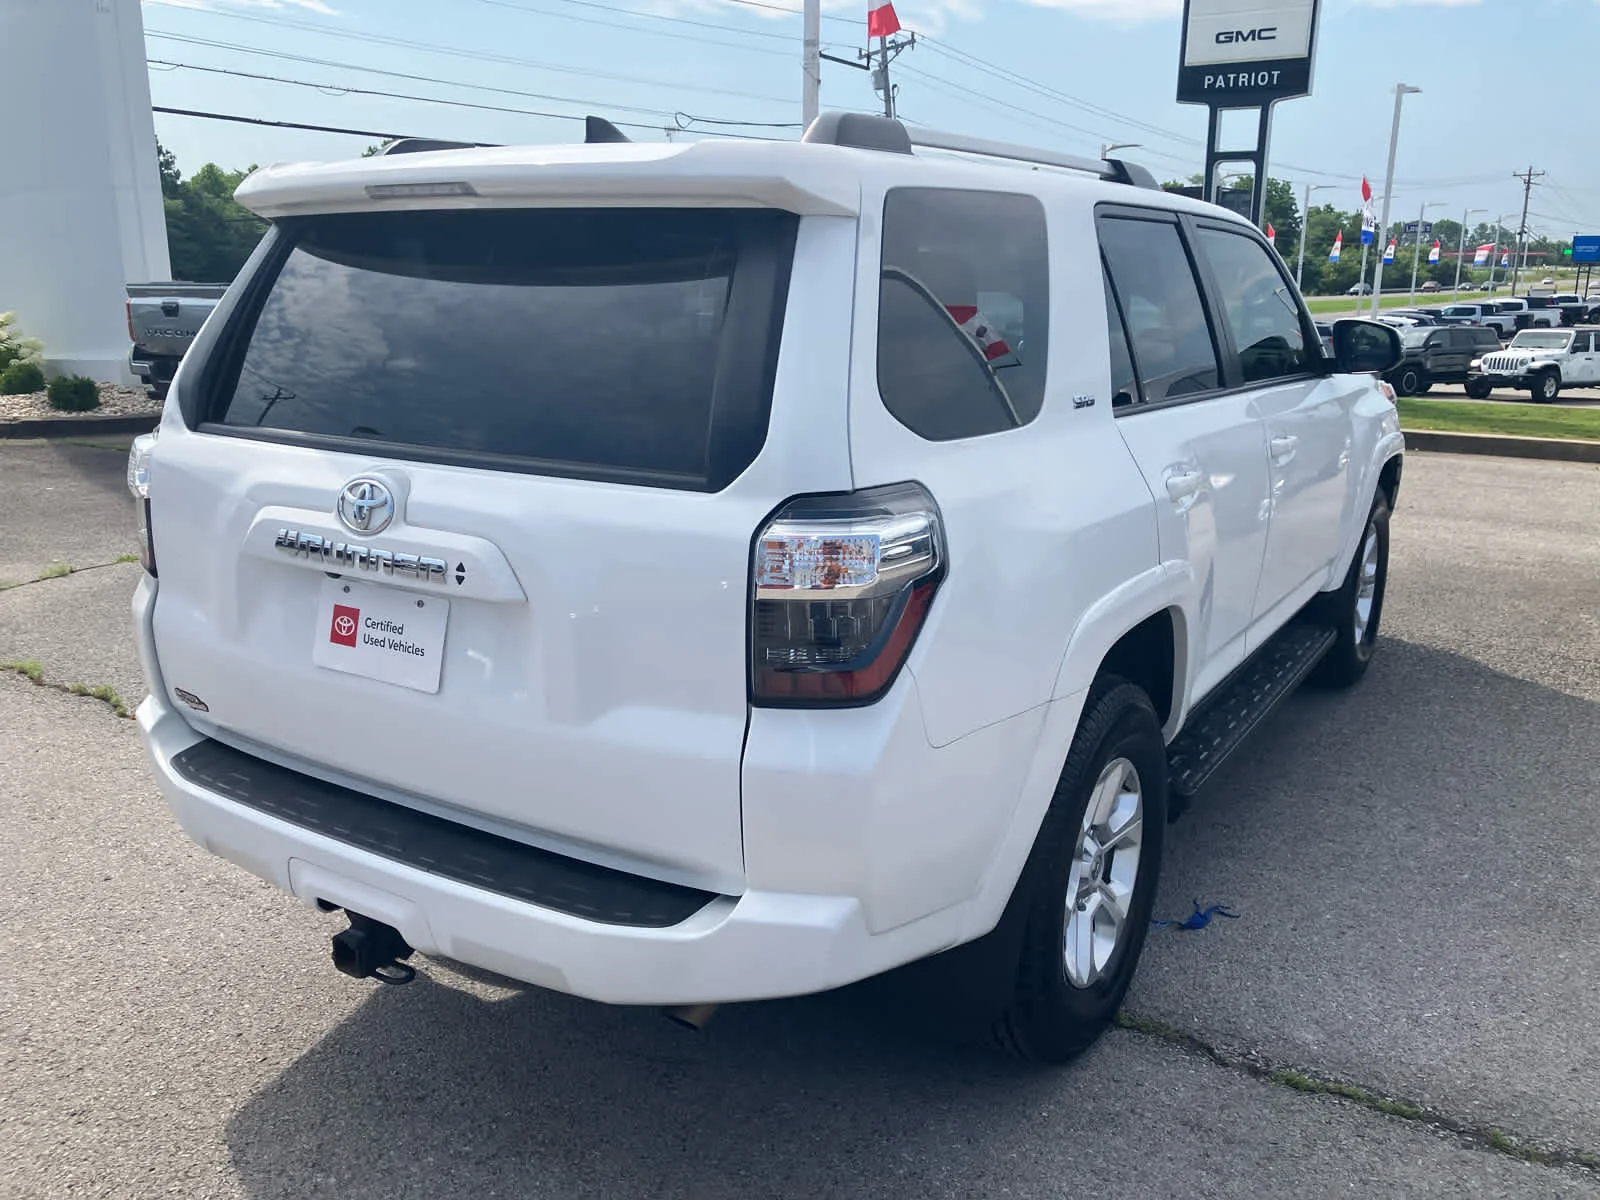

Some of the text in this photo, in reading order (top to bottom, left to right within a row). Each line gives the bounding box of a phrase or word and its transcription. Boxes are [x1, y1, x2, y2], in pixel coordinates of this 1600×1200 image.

[1215, 27, 1277, 44] GMC
[1204, 70, 1281, 89] PATRIOT
[144, 328, 197, 338] TACOM
[364, 617, 404, 635] Certified
[363, 633, 425, 657] Used Vehicles
